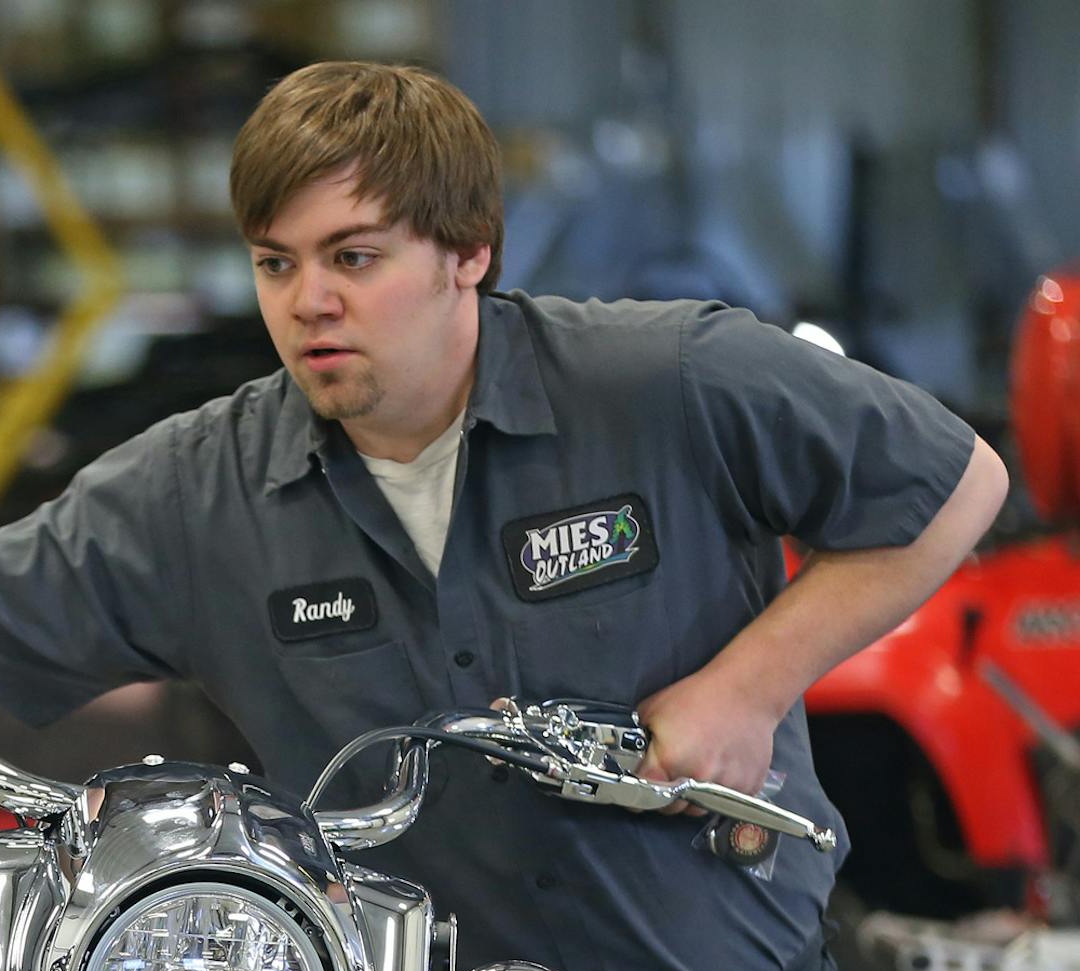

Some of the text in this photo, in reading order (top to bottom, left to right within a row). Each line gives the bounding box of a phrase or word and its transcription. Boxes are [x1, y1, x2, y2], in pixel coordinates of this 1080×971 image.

[530, 515, 609, 560] MIES
[535, 543, 614, 584] OUTLAND
[292, 591, 356, 623] Randy
